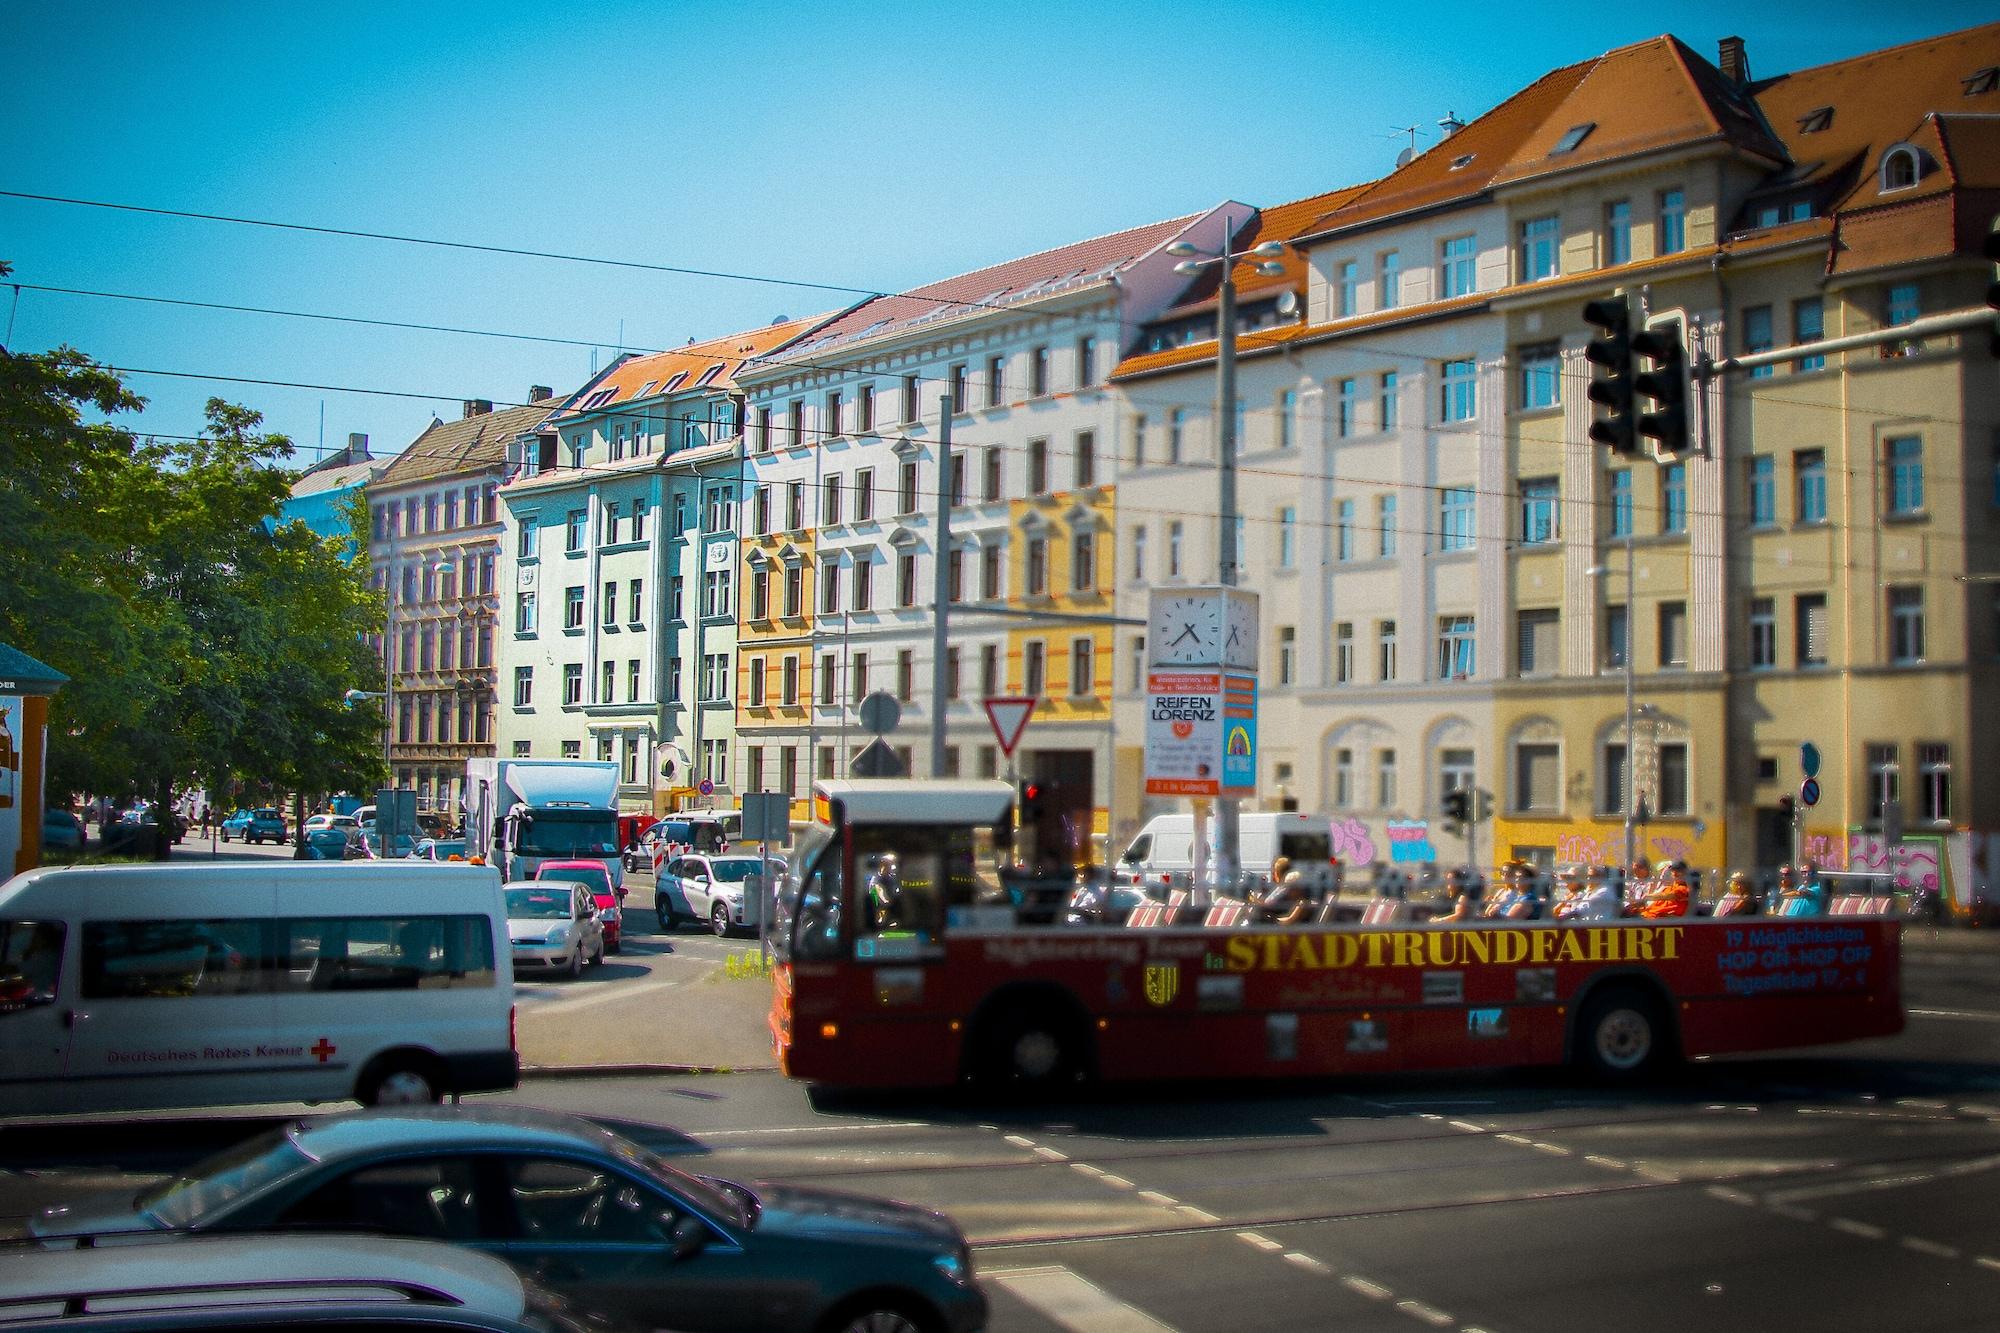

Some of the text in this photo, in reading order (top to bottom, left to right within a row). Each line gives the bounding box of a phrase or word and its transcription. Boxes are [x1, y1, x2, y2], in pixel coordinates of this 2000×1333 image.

[1156, 697, 1211, 709] REIFEN
[1152, 709, 1215, 721] LORENZ
[1226, 927, 1684, 971] STADTRUNDFAHRT
[1726, 927, 1865, 950] 19 Möglichkeiten
[1717, 951, 1758, 970] HOP
[1841, 945, 1873, 965] OFF
[107, 1044, 304, 1064] Deutsches Rotes Kreuz
